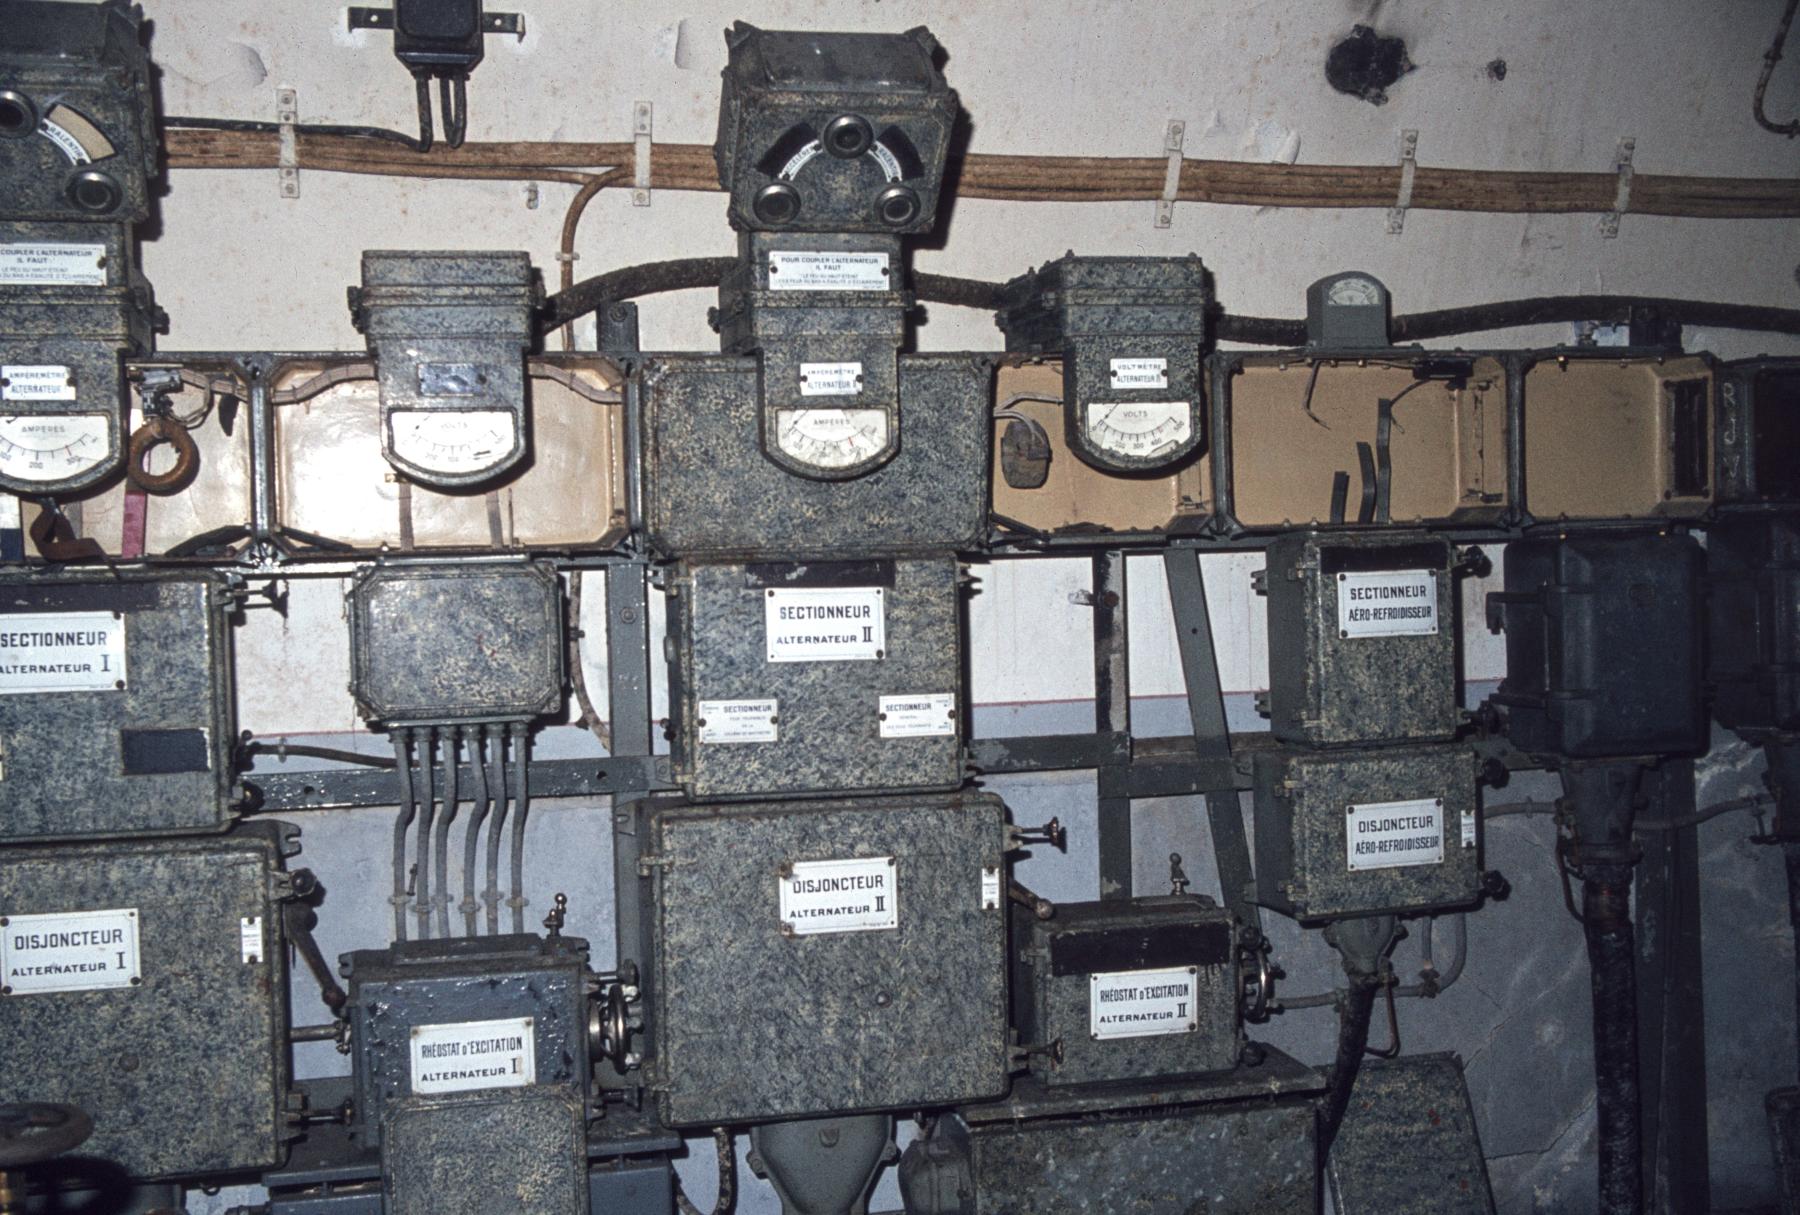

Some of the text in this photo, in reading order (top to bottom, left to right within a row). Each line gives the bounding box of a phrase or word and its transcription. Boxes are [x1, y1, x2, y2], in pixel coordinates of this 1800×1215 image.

[807, 380, 851, 389] ALTERNATEUR
[1350, 585, 1427, 600] SECTIONNEUR
[780, 605, 871, 620] SECTIONNEUR
[1348, 605, 1432, 622] AÉRO-REFROIDISSEUR
[1, 631, 108, 648] SECTIONNEUR
[776, 626, 873, 645] ALTERNATEUR II
[0, 654, 110, 674] ALTERNATEUR I
[723, 704, 772, 714] SECTIONNEUR
[886, 702, 932, 712] SECTIONNEUR
[1358, 815, 1434, 833] DISJONCTEUR
[1355, 836, 1440, 855] AÉRO-REFROIDISSEUR
[793, 874, 884, 894] DISJONCTEUR
[790, 895, 886, 919] ALTERNATEUR II
[15, 928, 123, 951] DISJONCTEUR
[11, 951, 126, 977] ALTERNATEUR I
[1100, 986, 1138, 1002] RHÉOSTAT
[1099, 1003, 1188, 1024] ALTERNATEUR II
[421, 1041, 460, 1059] RHÉOSTAT
[421, 1057, 518, 1082] ALTERNATEUR I
